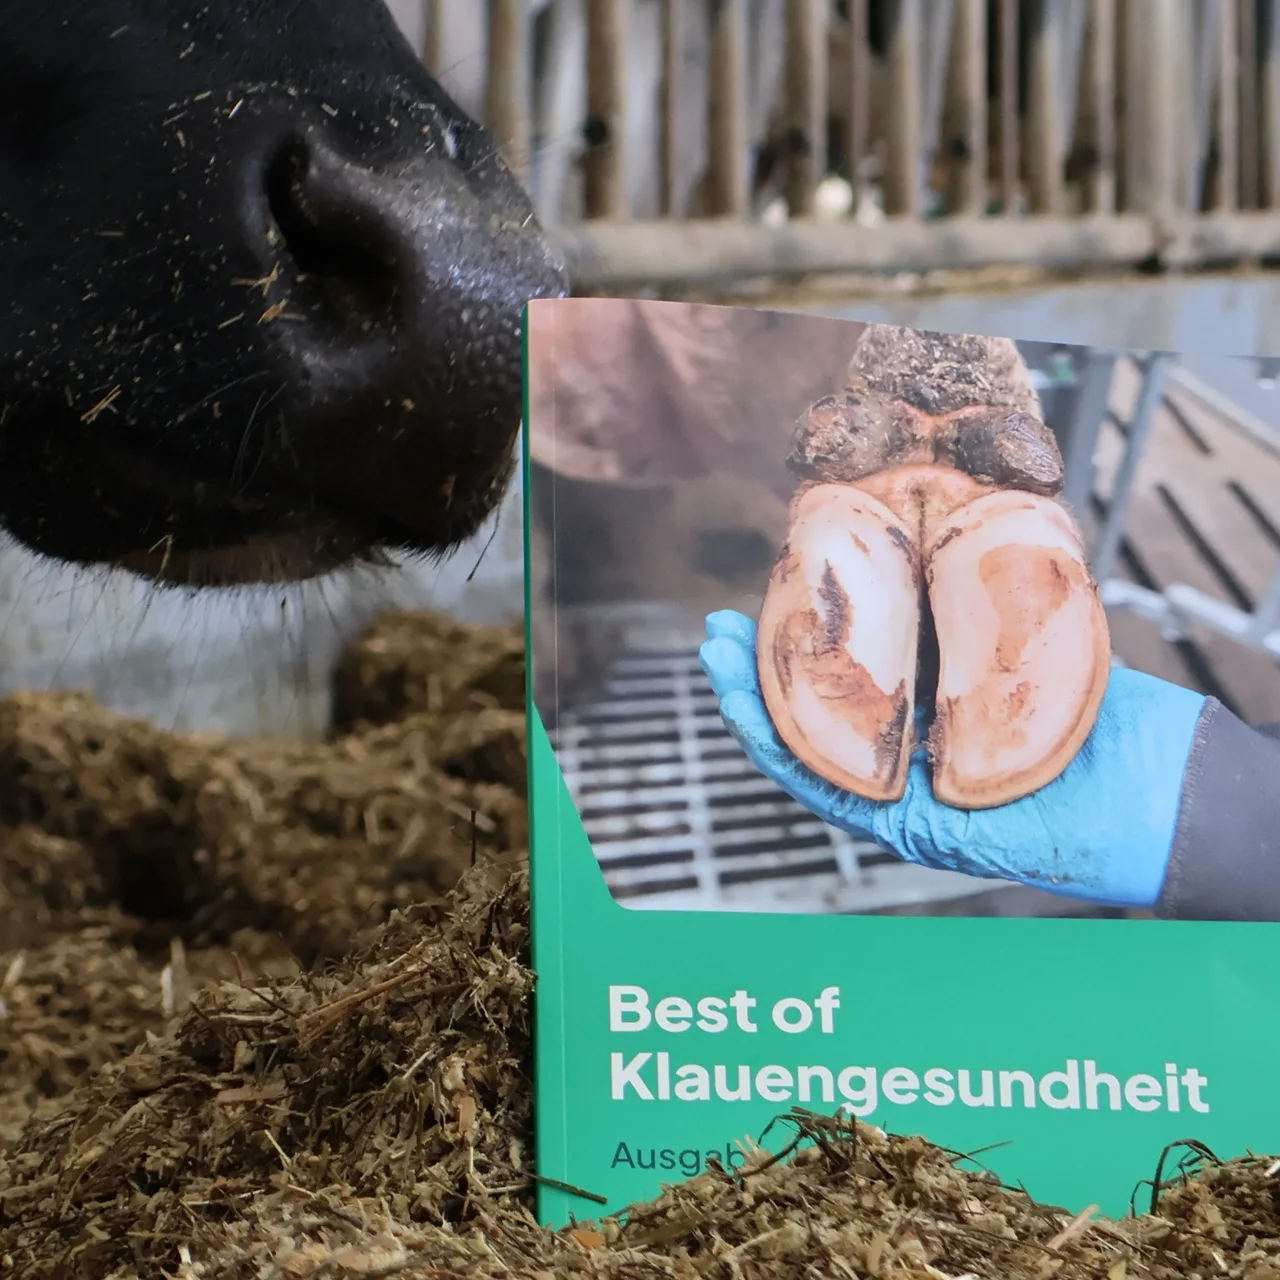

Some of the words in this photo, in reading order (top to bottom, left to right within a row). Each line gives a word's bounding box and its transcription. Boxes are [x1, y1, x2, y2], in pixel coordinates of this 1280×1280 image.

[609, 984, 757, 1034] Best
[770, 986, 842, 1034] of
[609, 1051, 1211, 1117] Klauengesundheit
